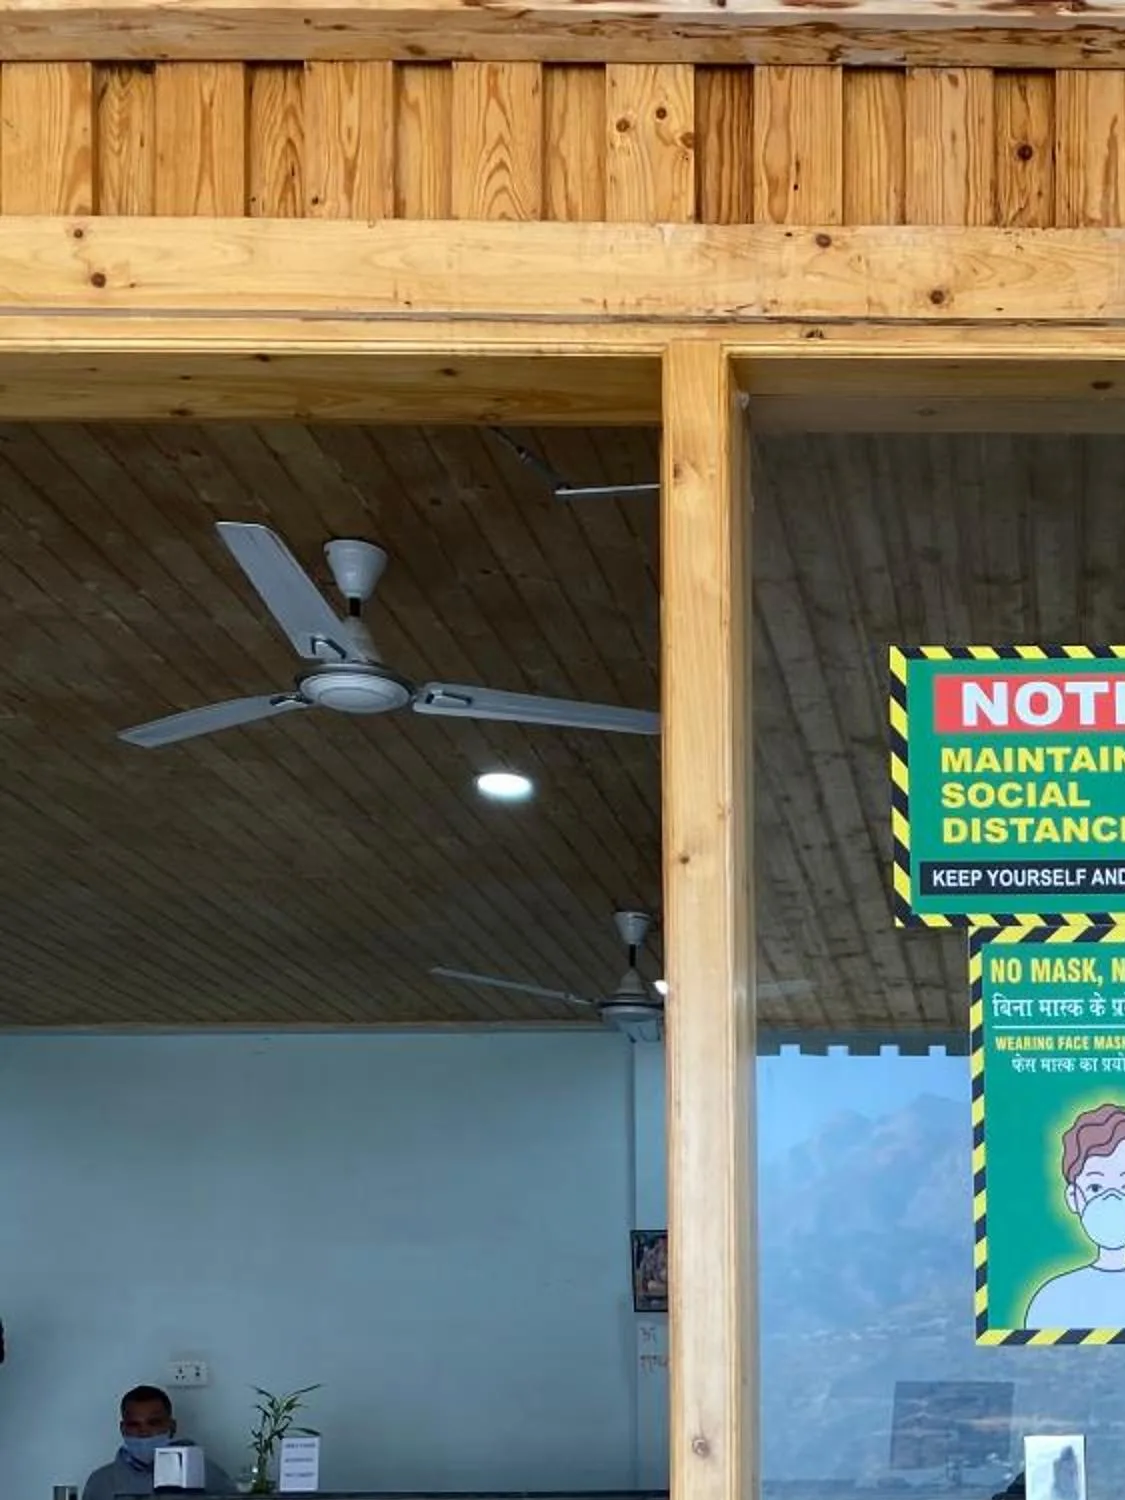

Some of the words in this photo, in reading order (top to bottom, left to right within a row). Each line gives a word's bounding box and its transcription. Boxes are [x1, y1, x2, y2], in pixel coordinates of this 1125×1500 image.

[940, 781, 1092, 809] SOCIAL
[932, 869, 983, 887] KEEP
[987, 868, 1087, 887] YOURSELF
[990, 957, 1023, 984] NO
[1031, 957, 1104, 988] MASK,
[992, 991, 1034, 1017] बिना
[1038, 998, 1085, 1017] मास्क
[1089, 991, 1107, 1017] के
[995, 1035, 1054, 1051] WEARING
[1057, 1035, 1089, 1051] FACE
[1040, 1057, 1076, 1073] मास्क
[1079, 1056, 1099, 1073] का
